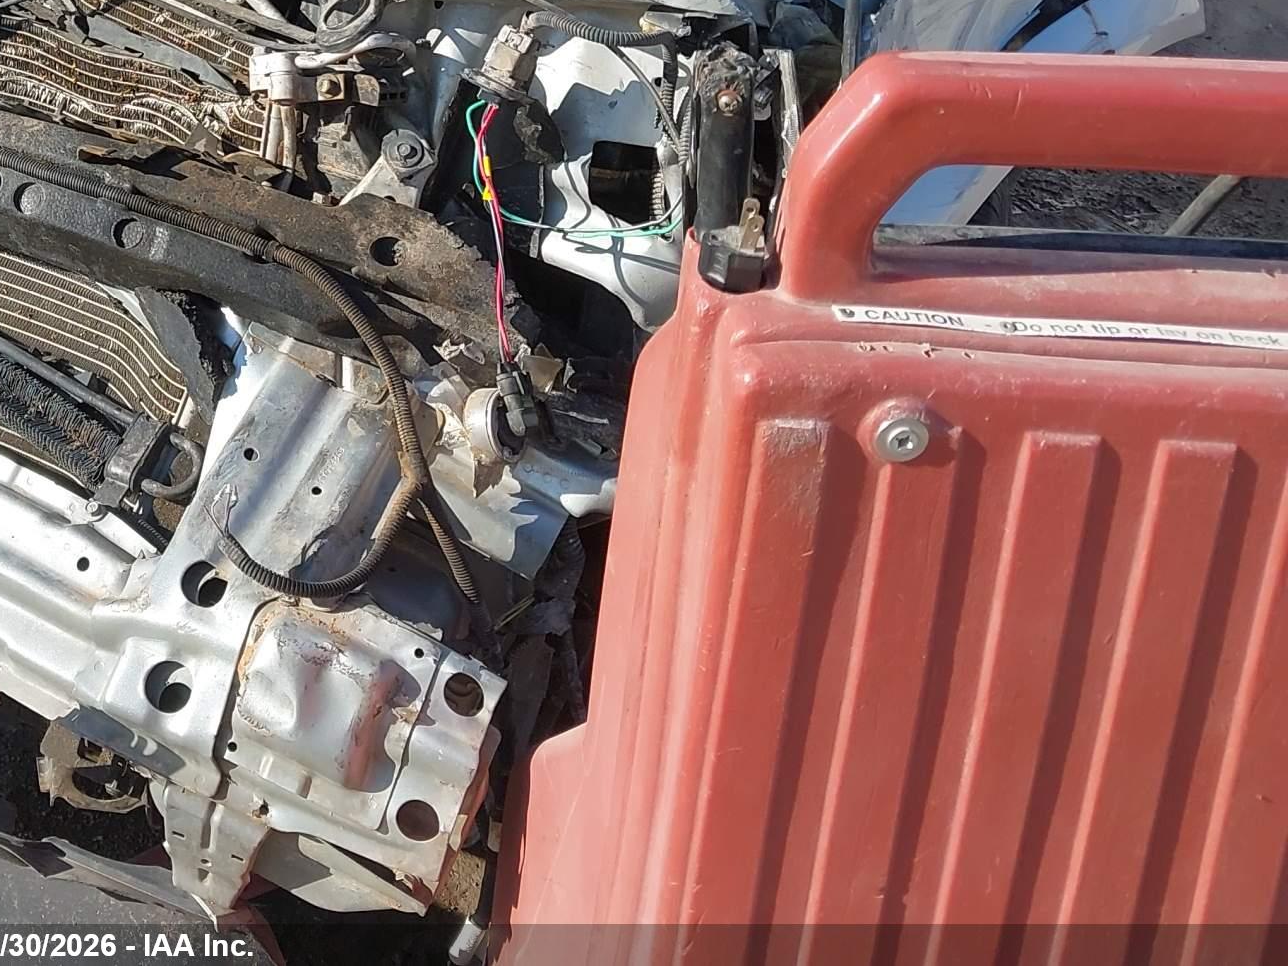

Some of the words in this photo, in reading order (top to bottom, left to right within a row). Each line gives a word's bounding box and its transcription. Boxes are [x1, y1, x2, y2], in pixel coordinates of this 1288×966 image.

[864, 309, 965, 327] CAUTION
[1049, 323, 1084, 333] not
[1091, 323, 1121, 335] tip
[1128, 326, 1150, 335] or
[1196, 330, 1224, 340] on
